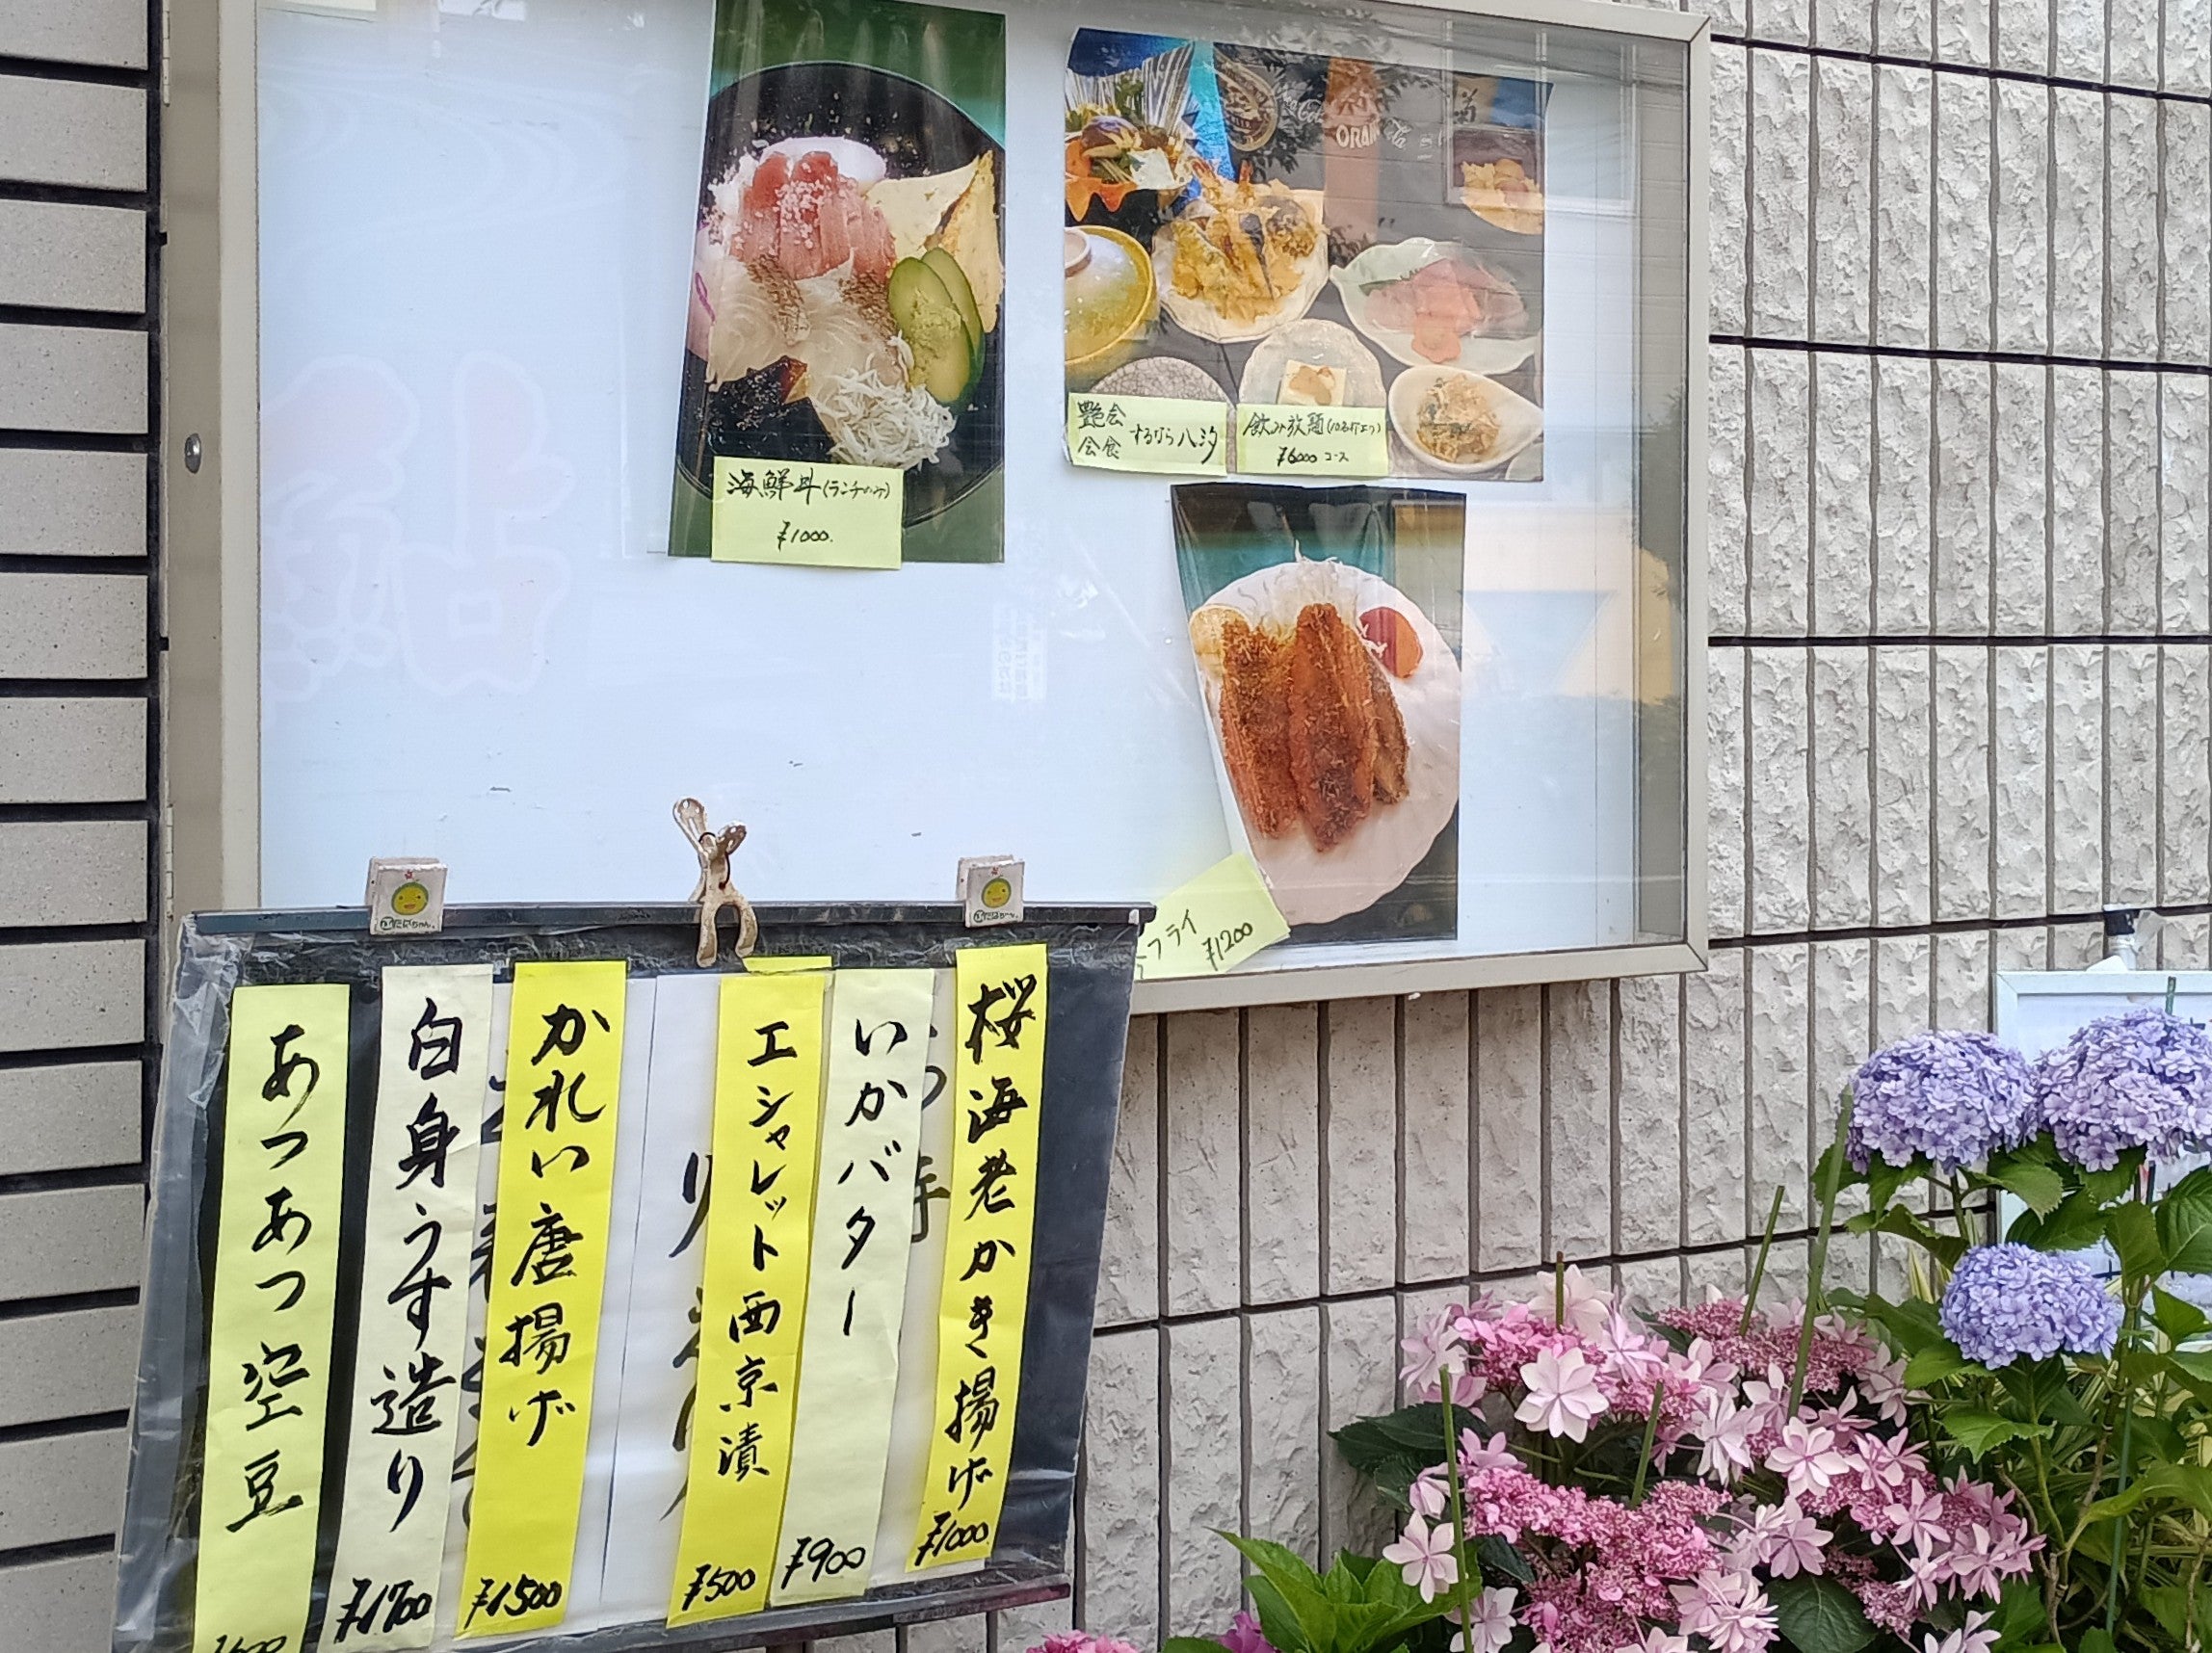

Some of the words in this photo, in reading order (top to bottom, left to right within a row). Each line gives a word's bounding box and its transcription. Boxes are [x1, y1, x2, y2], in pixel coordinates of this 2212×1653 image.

[1201, 922, 1253, 972] ¥1200
[835, 1018, 909, 1337] いかバター
[497, 1003, 612, 1448] かれい唐揚げ
[942, 973, 1041, 1512] 桜海老かき揚げ
[370, 997, 464, 1534] 白身うす造り
[780, 1536, 867, 1590] ¥900
[914, 1510, 990, 1567] ¥1000
[463, 1573, 563, 1630] ¥1500
[681, 1563, 756, 1613] ¥500
